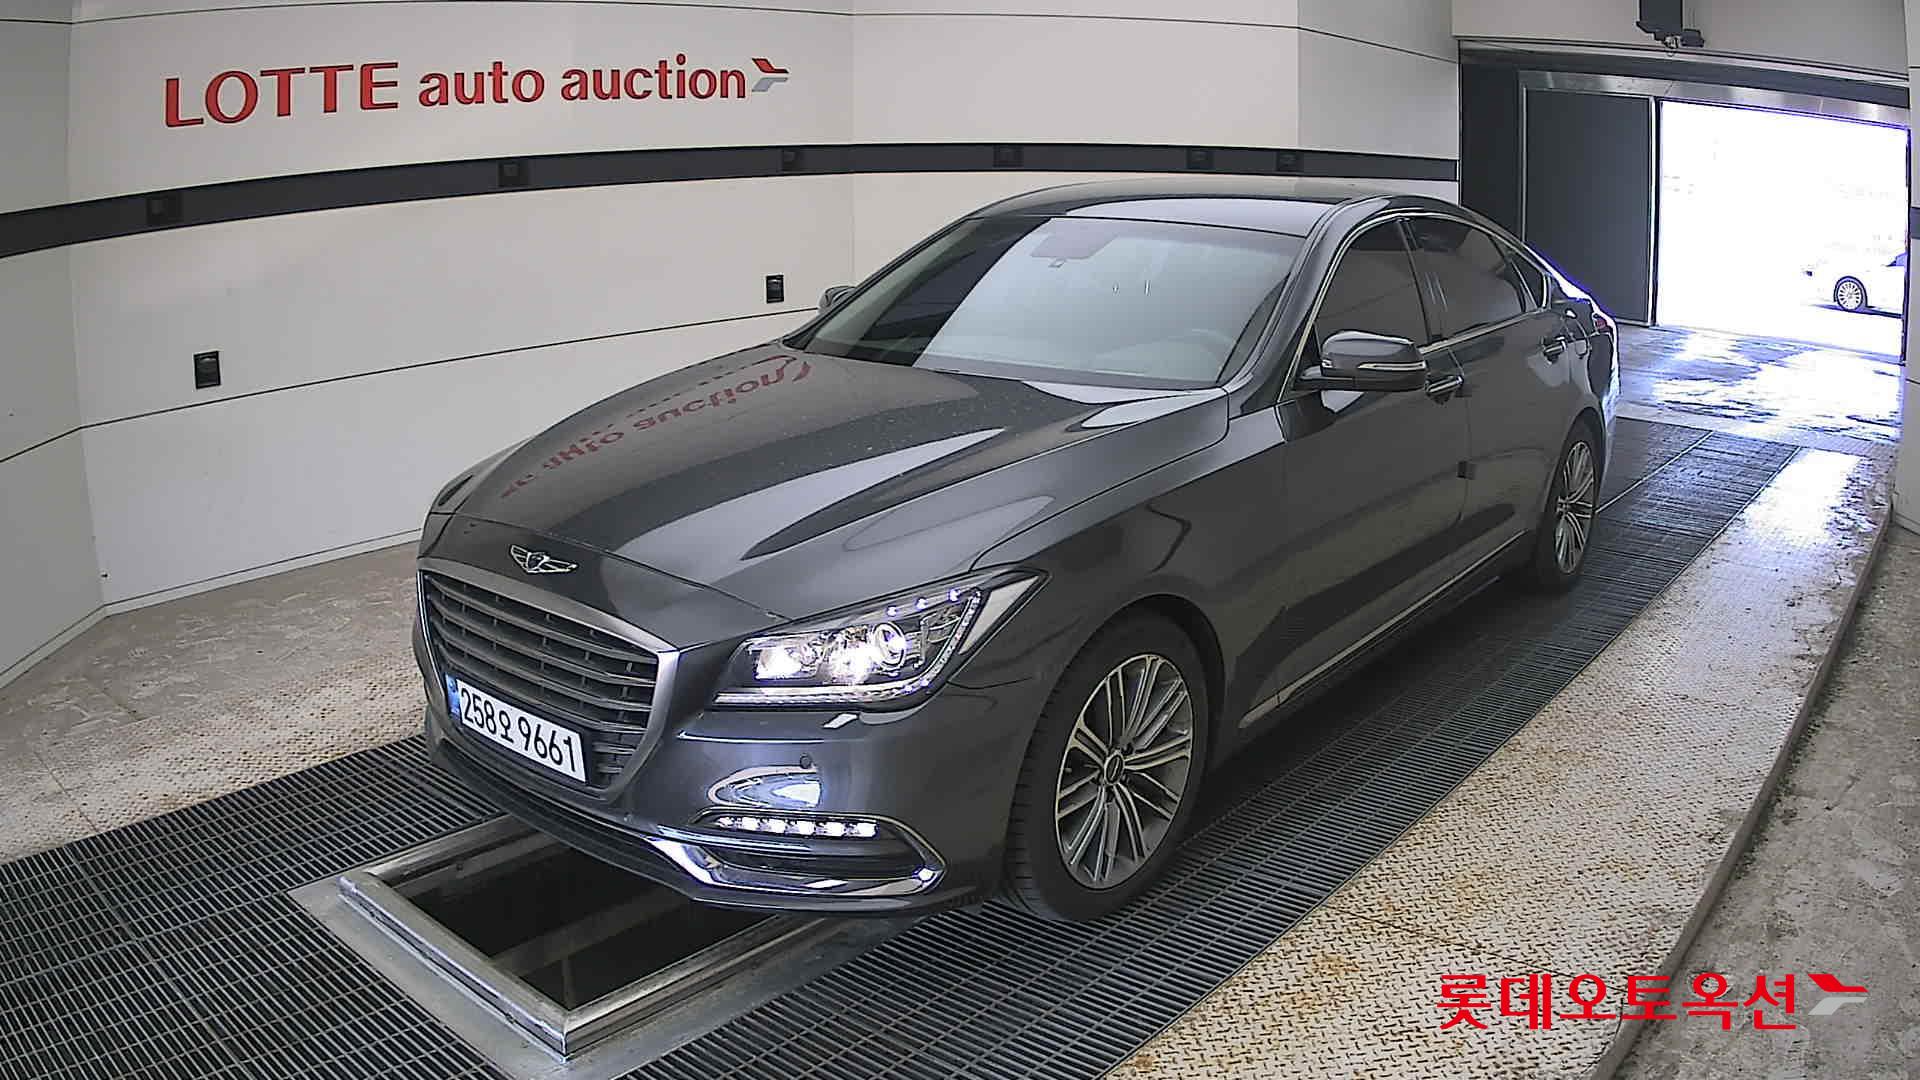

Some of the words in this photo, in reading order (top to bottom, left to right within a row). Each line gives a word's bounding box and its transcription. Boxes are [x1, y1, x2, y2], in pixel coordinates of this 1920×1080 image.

[165, 61, 399, 127] LOTTE
[419, 61, 546, 108] auto
[560, 53, 747, 101] auction
[460, 687, 515, 744] 258오
[517, 716, 576, 773] 9661
